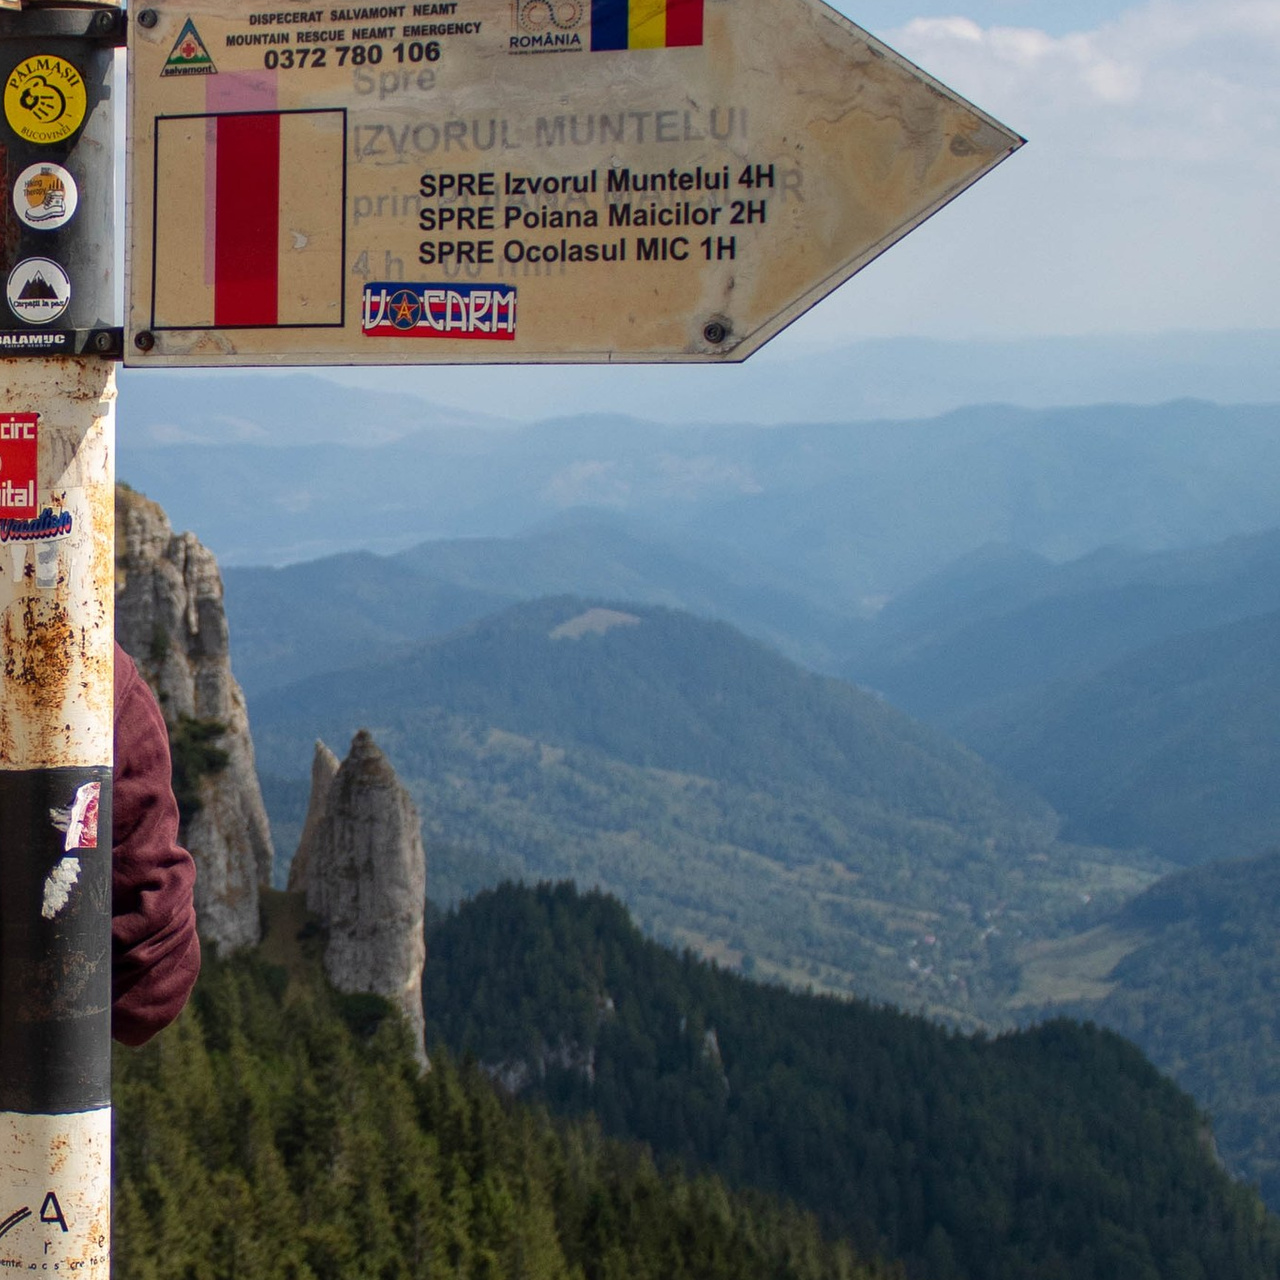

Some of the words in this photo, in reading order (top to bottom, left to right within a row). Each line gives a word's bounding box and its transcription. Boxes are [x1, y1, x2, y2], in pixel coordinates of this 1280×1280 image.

[249, 10, 323, 26] DISPECERAT
[330, 5, 406, 22] SALVAMONT
[412, 2, 458, 17] NEAMT
[226, 32, 290, 47] MOUNTAIN
[296, 29, 345, 44] RESCUE
[352, 25, 396, 41] NEAMT
[402, 22, 482, 38] EMERGENCY
[509, 31, 582, 49] ROMÂNIA
[263, 47, 327, 71] 0372
[334, 44, 384, 67] 780
[392, 41, 441, 63] 106
[164, 63, 213, 77] salvamont
[419, 173, 495, 197] SPRE
[504, 169, 597, 196] Izvorul
[606, 165, 731, 193] Muntelui
[737, 163, 775, 190] 4H
[419, 207, 495, 231] SPRE
[504, 205, 599, 229] Poiana
[608, 201, 723, 228] Maicilor
[729, 199, 767, 224] 2H
[418, 240, 495, 264] SPRE
[503, 237, 627, 263] Ocolasul
[635, 236, 691, 261] MIC
[699, 235, 737, 260] 1H
[0, 417, 35, 440] circ
